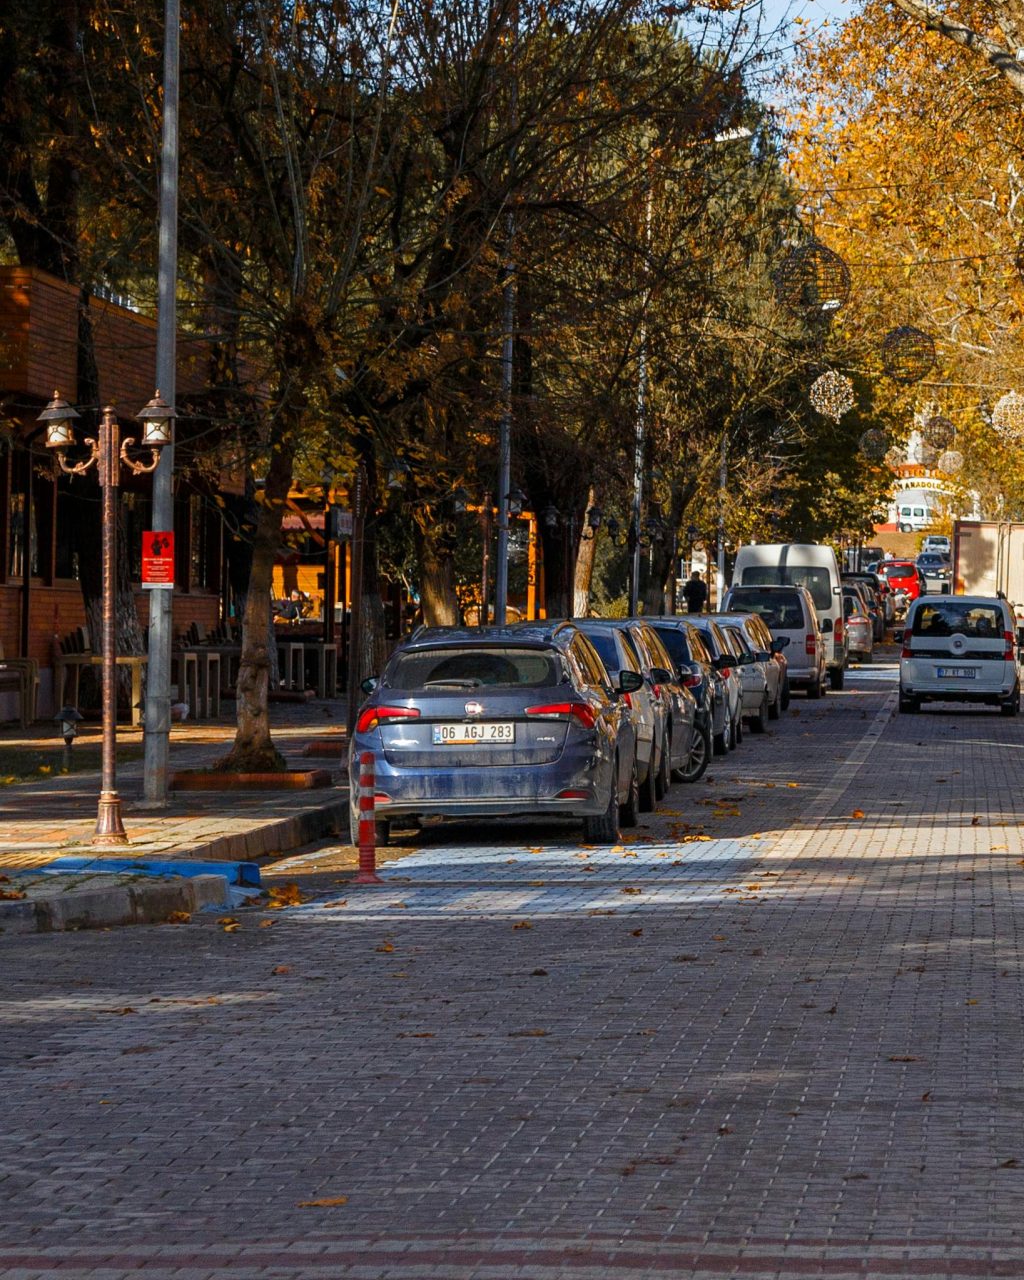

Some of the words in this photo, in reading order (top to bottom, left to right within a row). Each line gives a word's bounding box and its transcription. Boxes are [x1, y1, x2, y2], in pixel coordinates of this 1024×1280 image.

[905, 481, 941, 490] ANADOLU
[441, 726, 456, 739] 06
[464, 726, 485, 739] AGJ
[490, 725, 512, 738] 283
